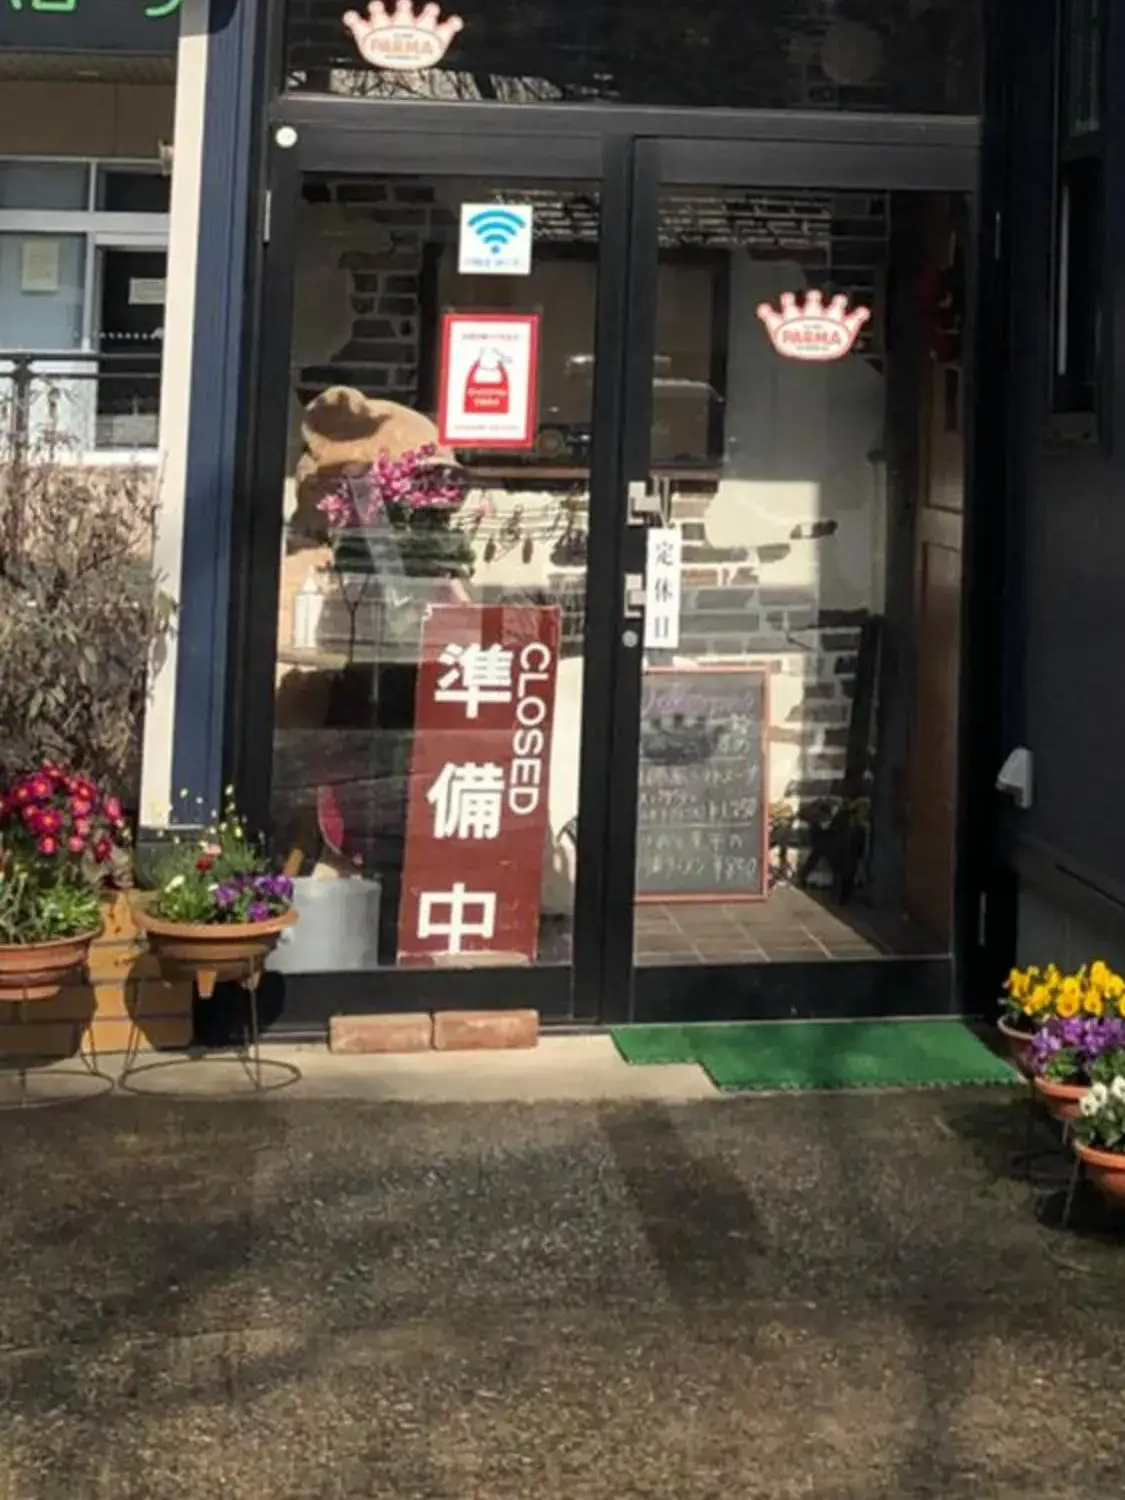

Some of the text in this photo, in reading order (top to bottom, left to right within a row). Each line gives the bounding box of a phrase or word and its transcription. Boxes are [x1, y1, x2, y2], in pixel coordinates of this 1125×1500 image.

[653, 540, 675, 639] 定休日
[417, 643, 514, 954] 準備中
[508, 642, 551, 815] CLOSED
